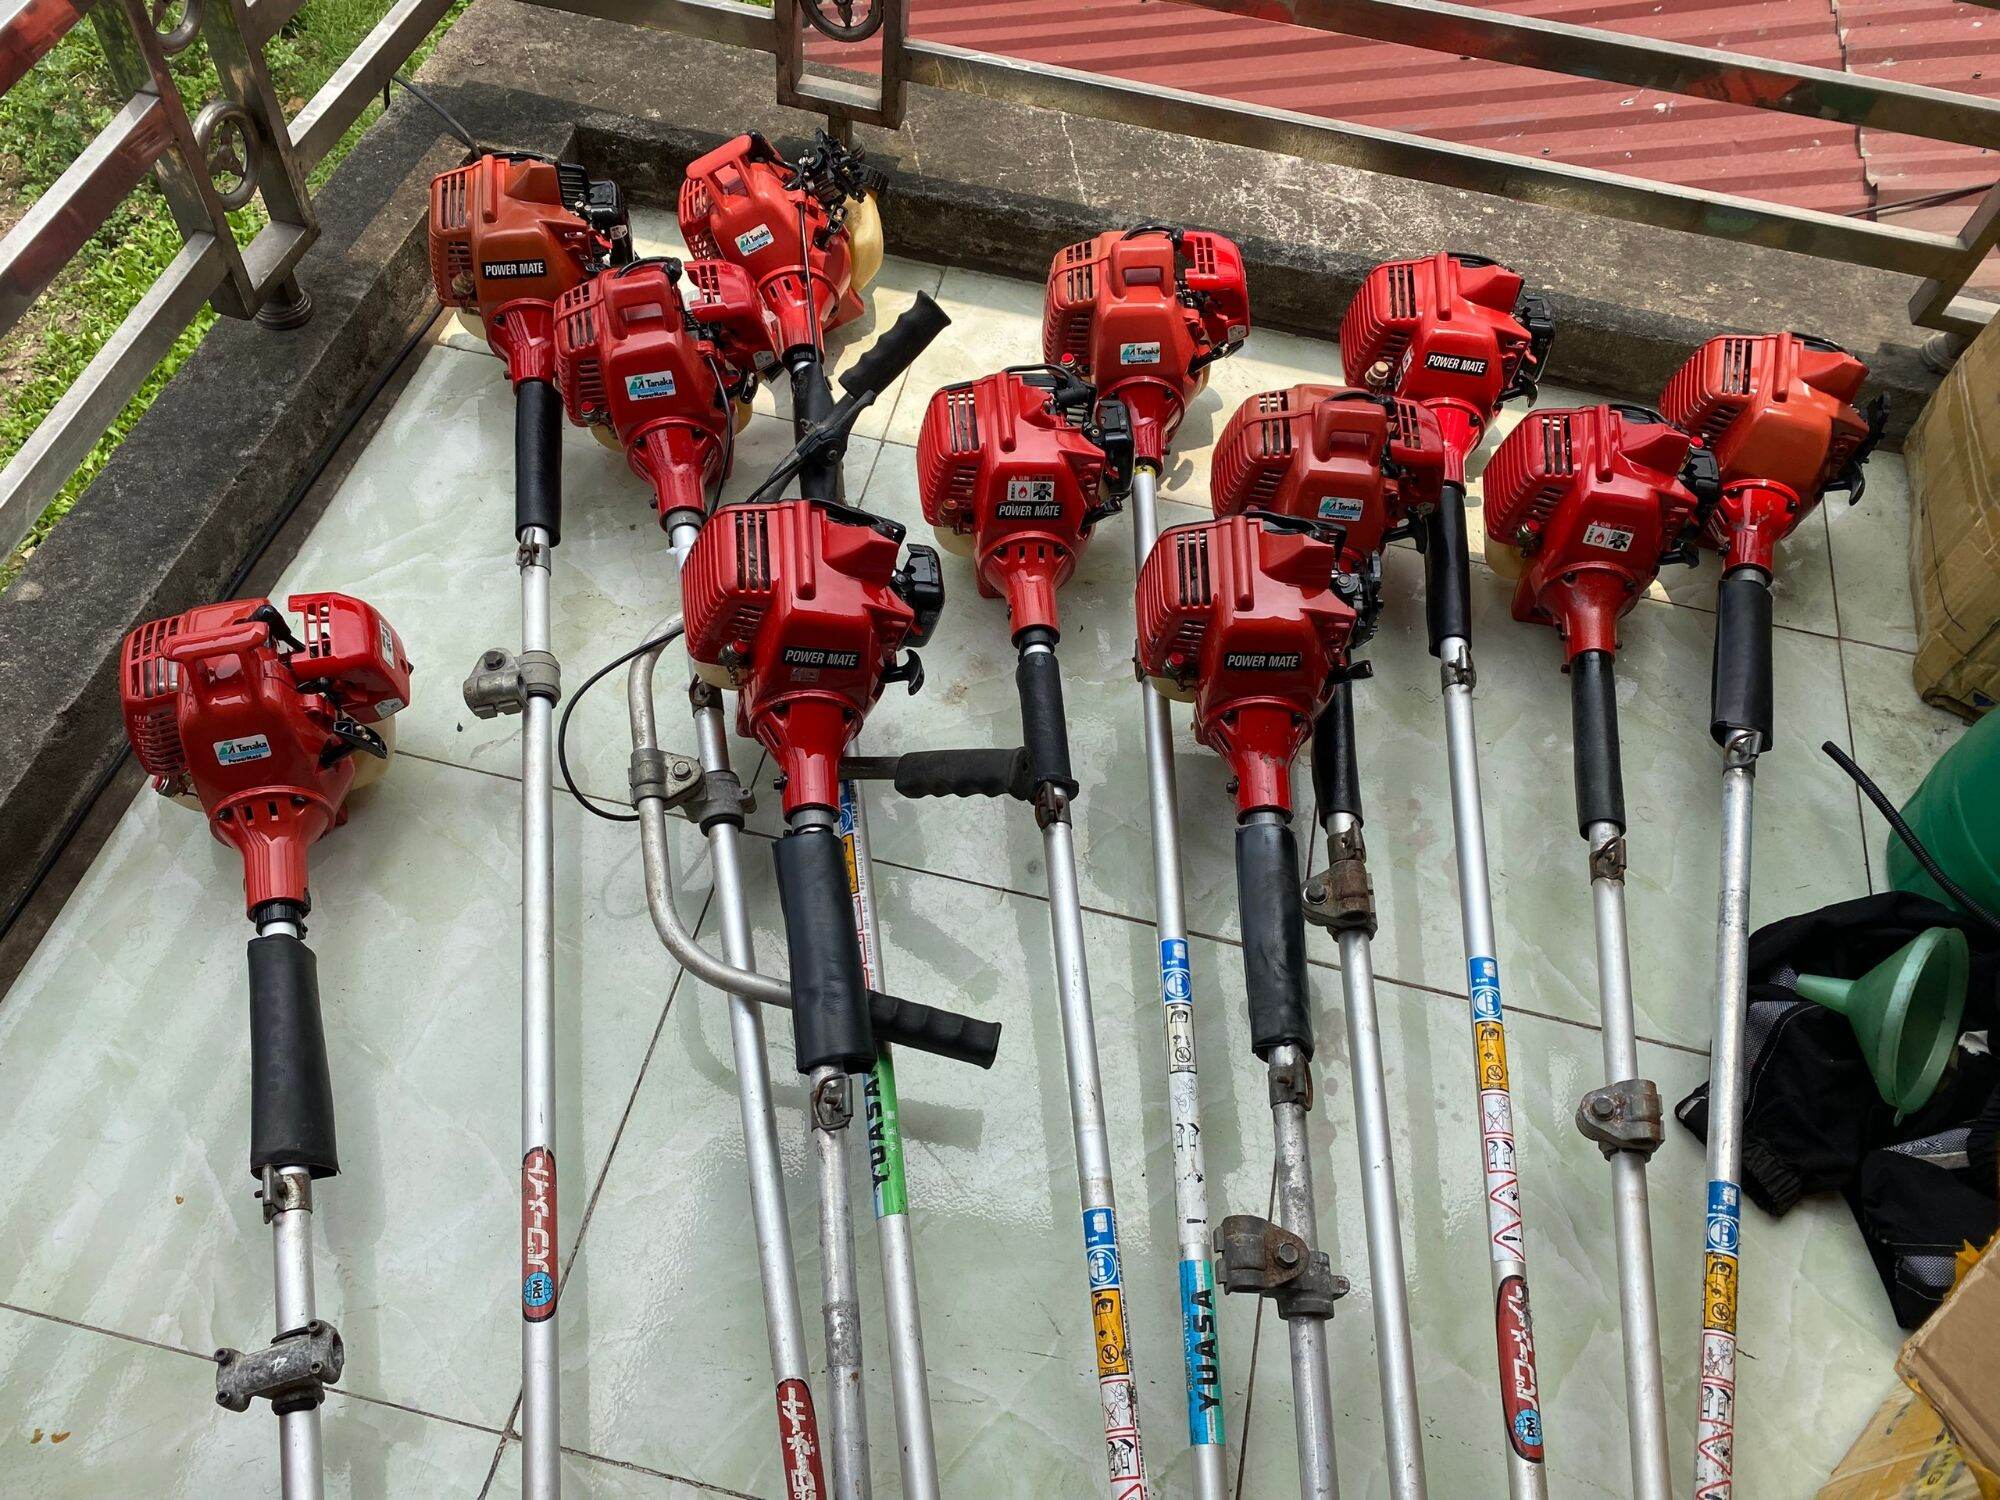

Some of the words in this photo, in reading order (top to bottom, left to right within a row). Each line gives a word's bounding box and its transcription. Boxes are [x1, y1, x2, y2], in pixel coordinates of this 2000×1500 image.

[749, 230, 769, 242] Tanaka
[485, 264, 517, 276] POWER
[519, 262, 544, 275] MATE
[1136, 346, 1160, 355] Tanaka
[1427, 355, 1459, 369] POWER
[1460, 359, 1486, 373] MATE
[645, 376, 673, 388] Tanaka
[998, 505, 1033, 516] POWER
[1034, 505, 1060, 516] MATE
[1338, 502, 1362, 512] Tanaka
[785, 649, 825, 664] POWER
[827, 653, 858, 666] MATE
[1227, 655, 1266, 667] POWER
[1268, 655, 1299, 667] MATE
[236, 740, 268, 752] Tanaka
[864, 1077, 890, 1192] YUASA
[527, 1156, 550, 1273] パワーメイト
[532, 1279, 543, 1300] PM
[1191, 1288, 1221, 1413] YUASA
[1526, 1416, 1537, 1438] PM
